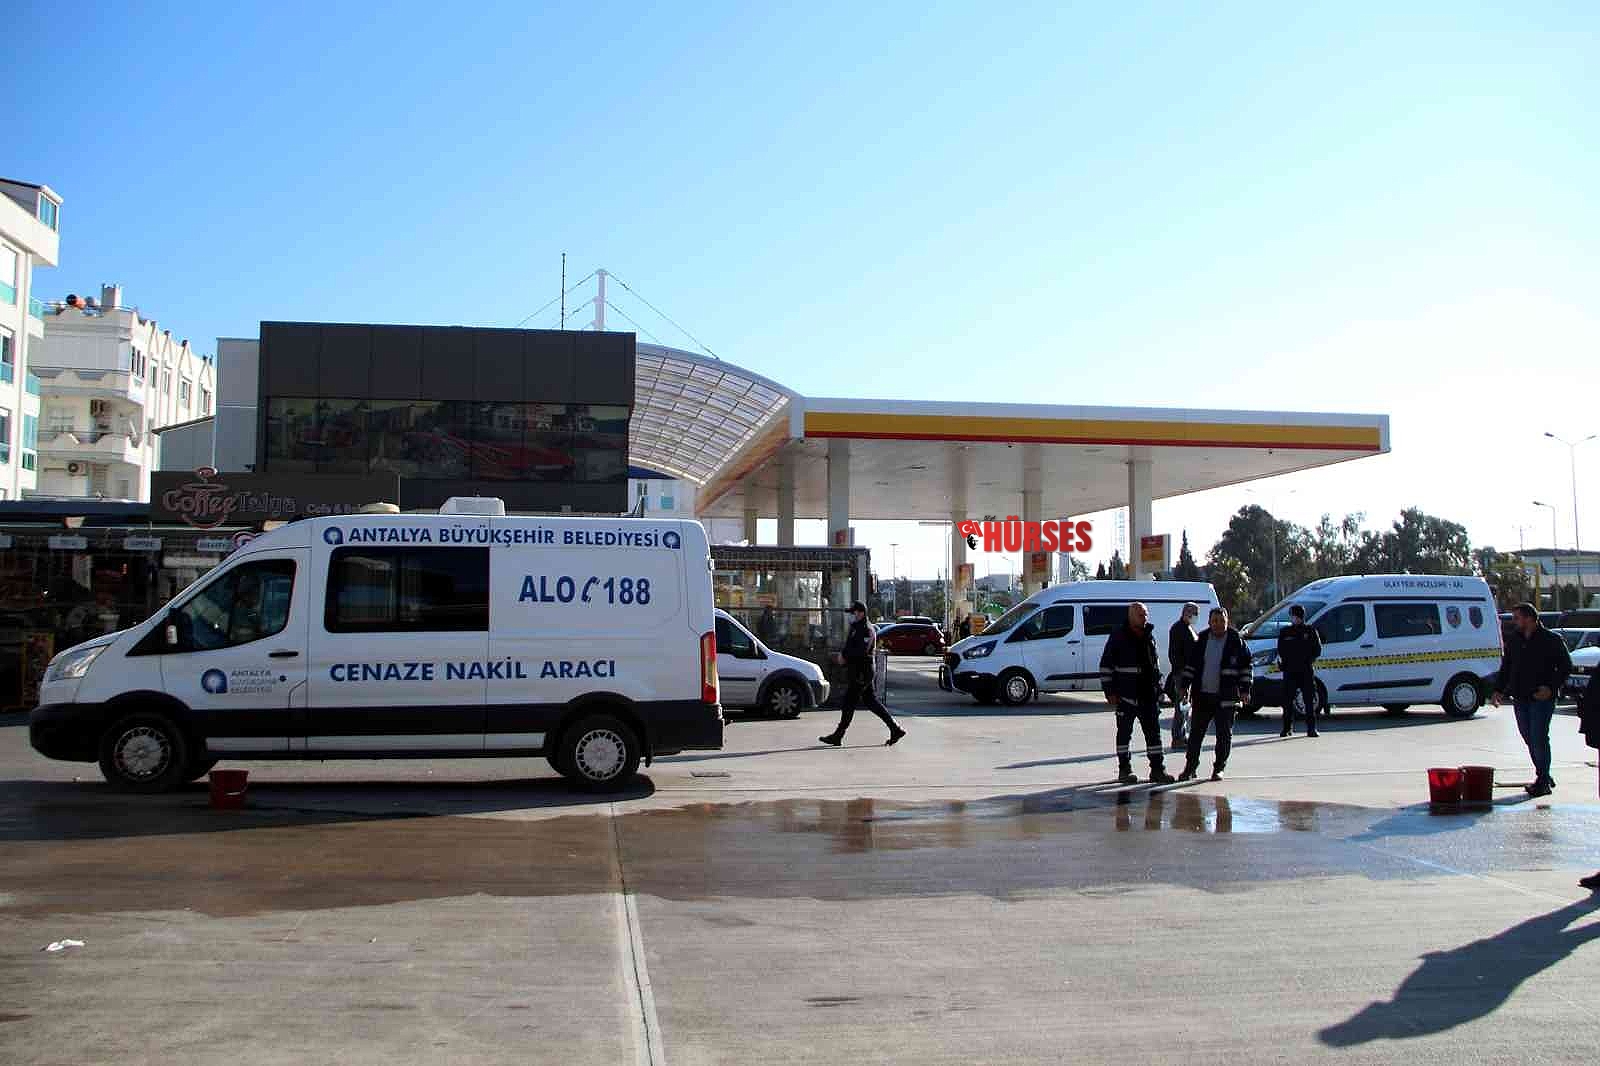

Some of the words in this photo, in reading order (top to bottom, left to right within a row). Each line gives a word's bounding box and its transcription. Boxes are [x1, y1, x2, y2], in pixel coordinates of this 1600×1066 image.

[348, 527, 433, 544] ANTALYA
[439, 525, 555, 549] BÜYÜKŞEHİR
[563, 527, 659, 548] BELEDİYESİ
[518, 575, 576, 604] ALO
[603, 576, 651, 606] 188
[328, 662, 435, 682] CENAZE
[446, 656, 529, 680] NAKİL
[539, 659, 616, 679] ARACI
